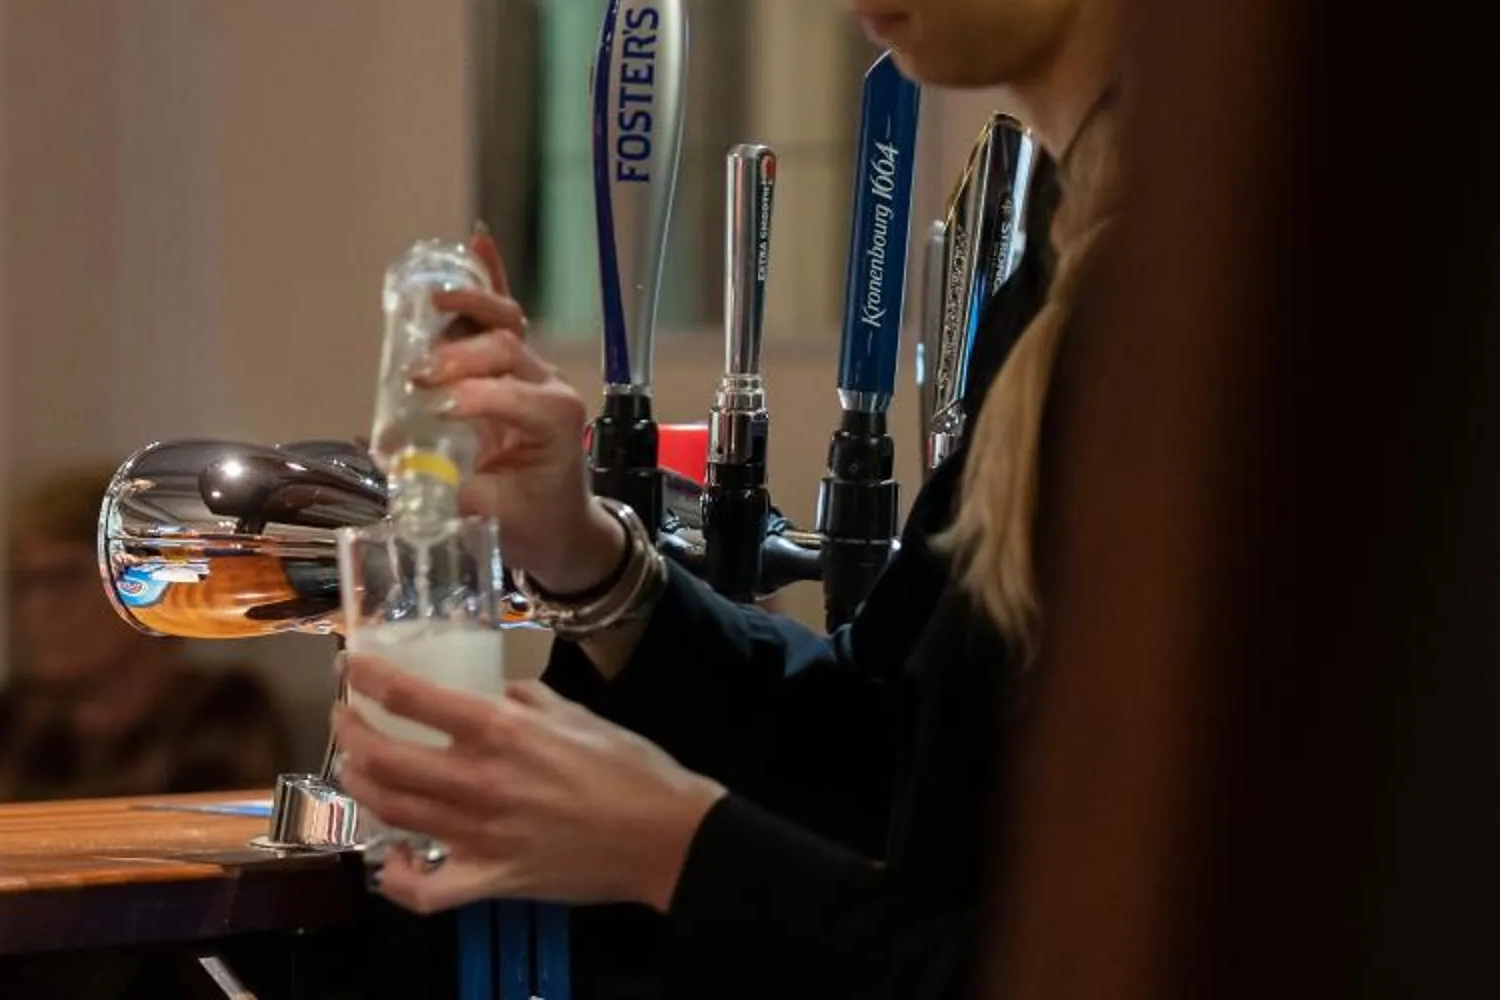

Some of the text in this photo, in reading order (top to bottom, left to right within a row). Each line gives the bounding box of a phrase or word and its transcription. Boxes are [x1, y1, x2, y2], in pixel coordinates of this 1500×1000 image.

[616, 7, 660, 183] FOSTER'S
[760, 187, 771, 239] SMOOTH
[861, 140, 899, 327] Kronenbourg 1664
[991, 222, 1014, 298] STRONG
